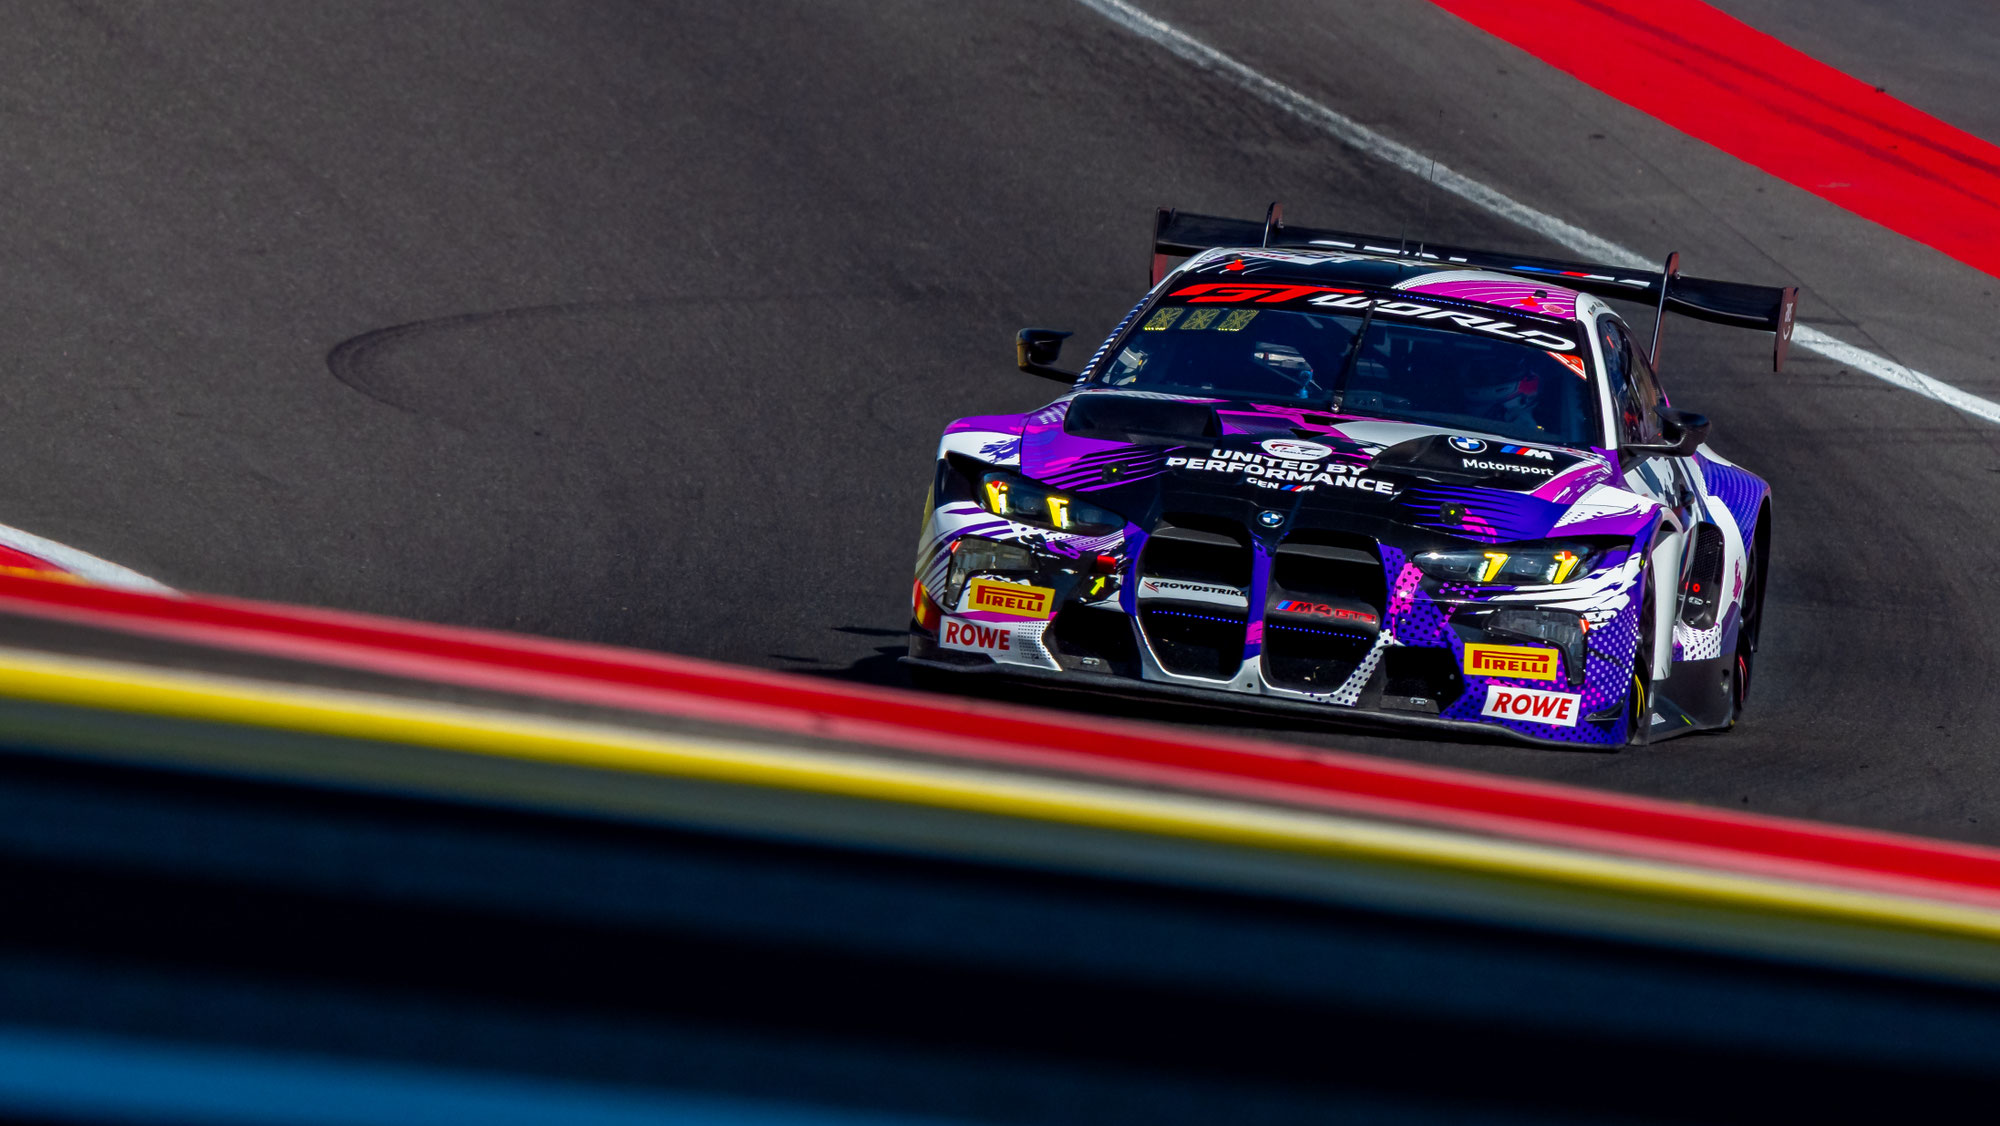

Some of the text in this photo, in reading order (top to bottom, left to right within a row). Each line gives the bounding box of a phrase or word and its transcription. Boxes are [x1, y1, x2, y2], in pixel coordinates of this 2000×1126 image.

[1168, 283, 1365, 303] GT
[1307, 294, 1576, 350] WORLD
[1210, 449, 1320, 473] UNITED
[1326, 463, 1369, 476] BY
[1462, 458, 1554, 476] Motorsport
[1246, 477, 1280, 490] GEN
[976, 584, 1046, 612] PIRELLI
[1151, 581, 1248, 597] CROWDSTRIKE
[1294, 602, 1332, 617] M4
[945, 621, 1011, 651] ROWE
[1472, 649, 1550, 673] PIRELLI
[1491, 692, 1573, 720] ROWE
